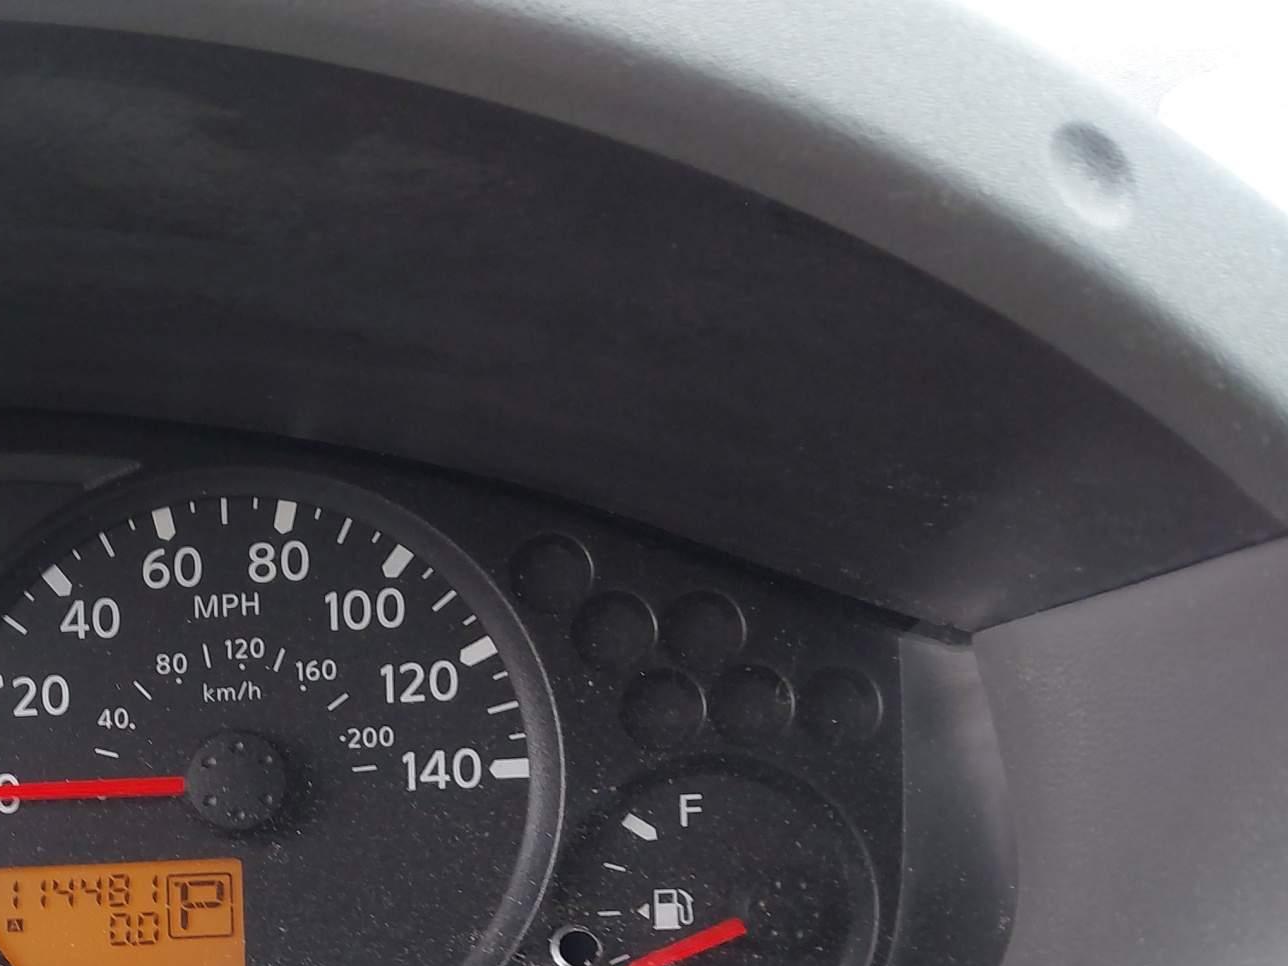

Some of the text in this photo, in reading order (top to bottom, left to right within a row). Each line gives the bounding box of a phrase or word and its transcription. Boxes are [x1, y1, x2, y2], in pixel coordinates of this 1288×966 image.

[142, 548, 202, 588] 60
[247, 539, 309, 582] 80
[60, 598, 120, 638] 40
[193, 592, 261, 618] MPH
[324, 587, 405, 630] 100
[156, 653, 187, 675] 80
[224, 638, 265, 660] 120
[296, 659, 337, 681] 160
[379, 660, 458, 703] 120
[13, 675, 69, 716] 20
[202, 680, 262, 703] km/h
[97, 709, 128, 730] 40
[348, 727, 394, 748] 200
[403, 749, 481, 790] 140
[679, 794, 702, 826] F
[12, 873, 159, 909] 114481
[177, 880, 225, 930] P
[110, 911, 160, 946] 0.0
